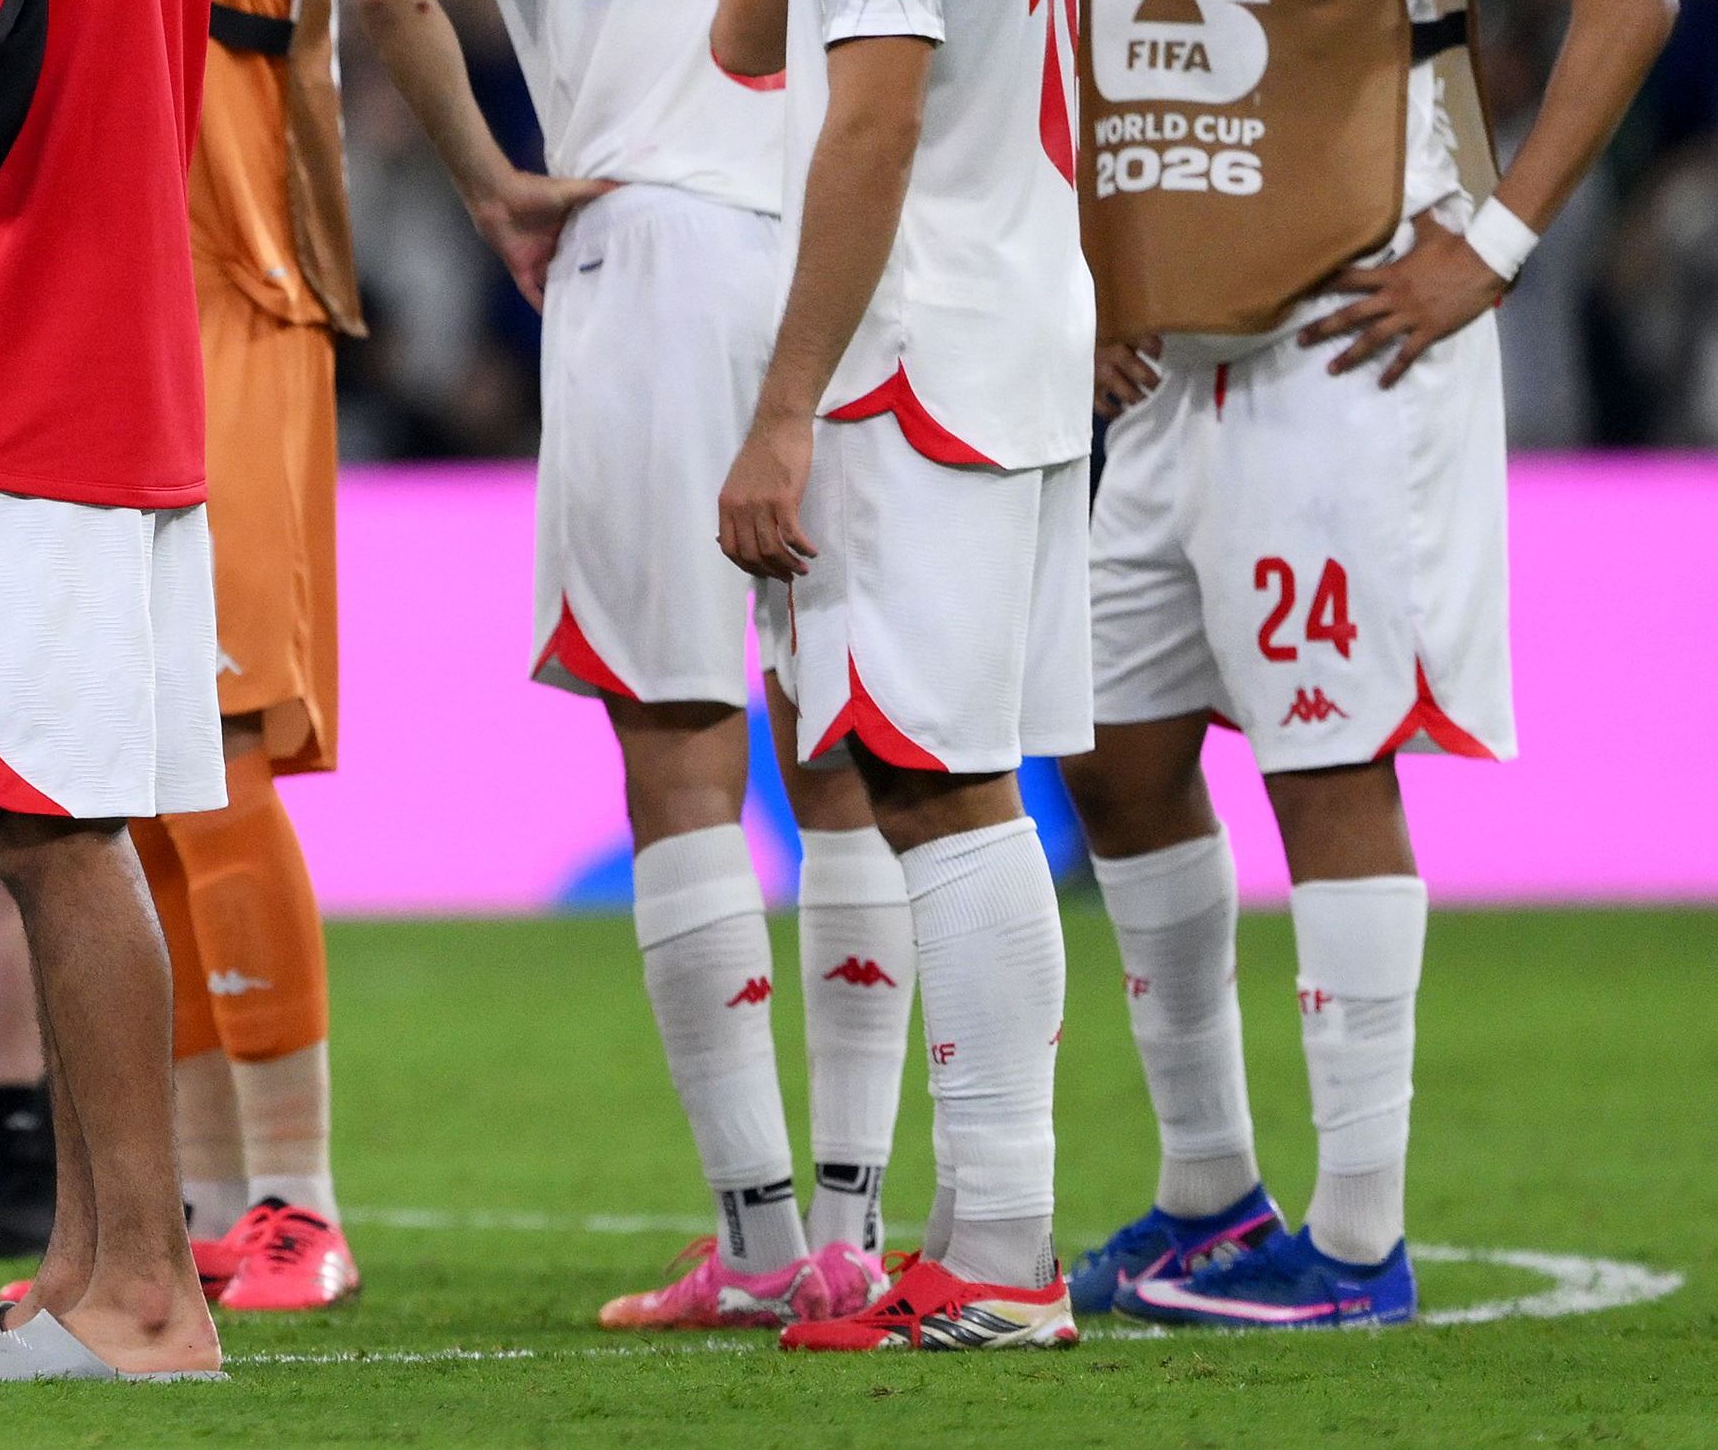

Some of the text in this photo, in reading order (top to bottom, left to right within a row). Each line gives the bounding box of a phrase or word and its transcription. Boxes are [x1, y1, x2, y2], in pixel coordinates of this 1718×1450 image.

[1126, 39, 1211, 72] FIFA
[1194, 113, 1265, 146] CUP
[1096, 146, 1262, 198] 2026
[1254, 556, 1358, 663] 24
